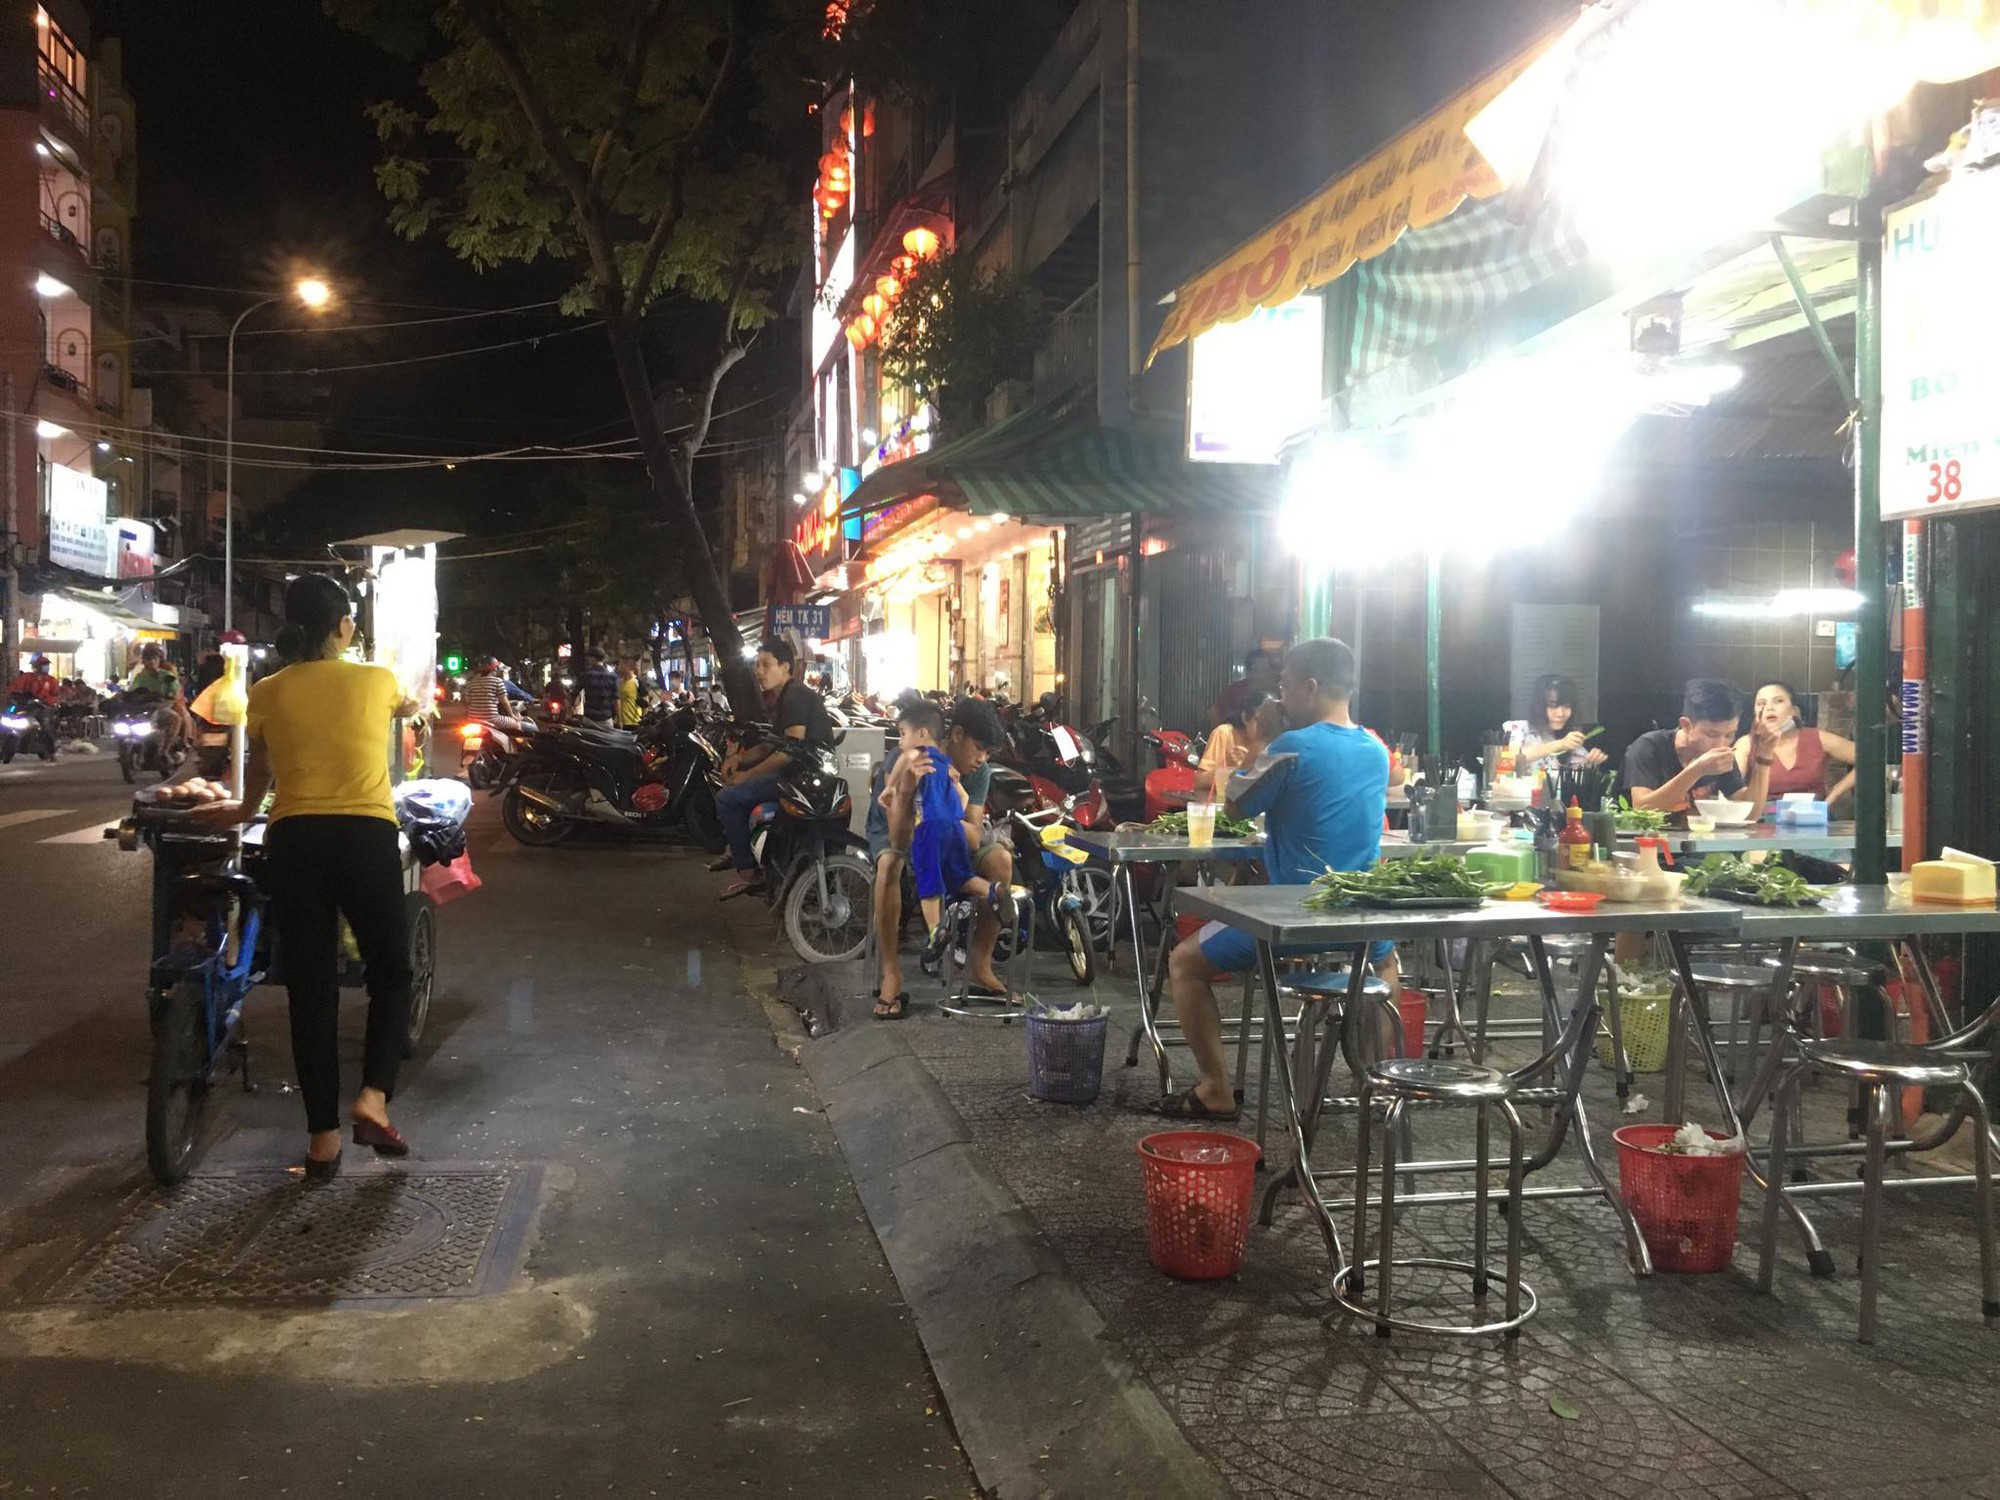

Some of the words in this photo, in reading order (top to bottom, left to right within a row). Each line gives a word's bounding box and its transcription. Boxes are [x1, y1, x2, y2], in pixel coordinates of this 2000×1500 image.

[1927, 459, 1963, 504] 38
[797, 609, 809, 625] TK
[812, 610, 823, 626] 31
